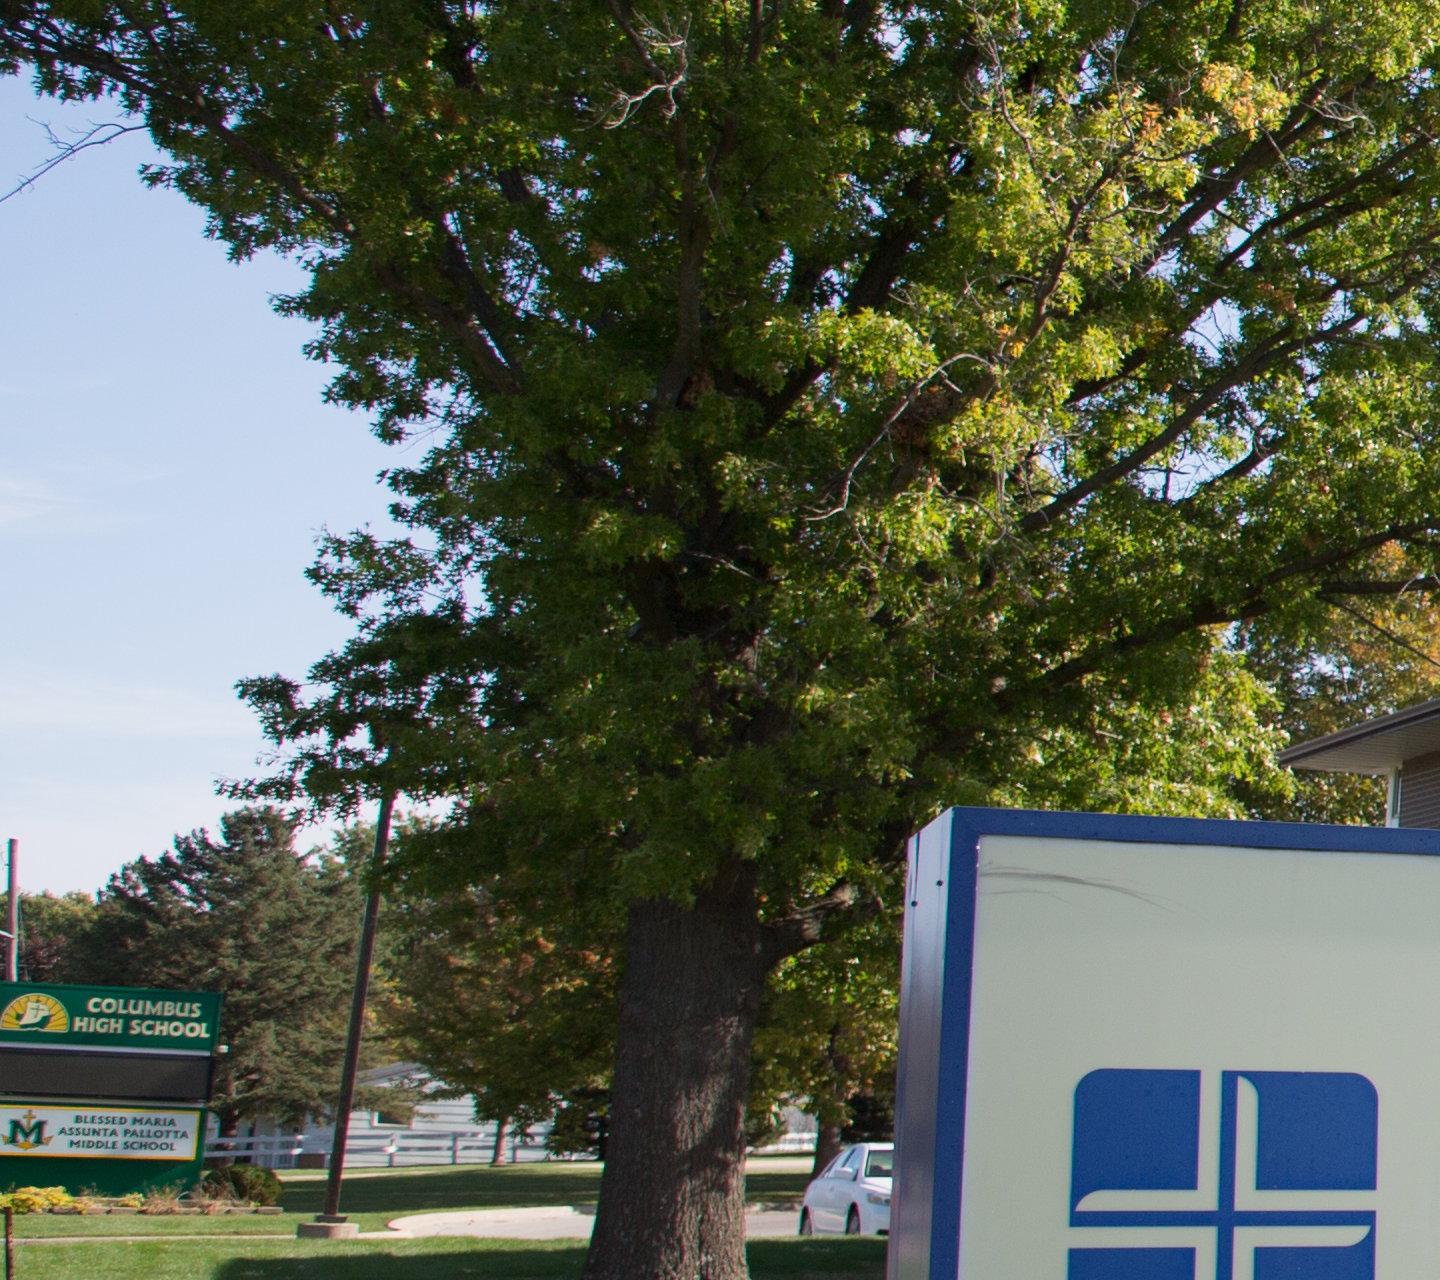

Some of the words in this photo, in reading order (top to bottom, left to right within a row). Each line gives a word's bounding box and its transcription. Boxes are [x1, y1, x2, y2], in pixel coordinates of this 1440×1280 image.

[87, 997, 202, 1018] COLUMBUS
[72, 1016, 124, 1034] HIGH
[129, 1020, 211, 1038] SCHOOL
[73, 1114, 128, 1126] BLESSED
[131, 1116, 177, 1127] MARIA
[58, 1126, 119, 1138] ASSUNTA
[123, 1128, 189, 1140] PALLOTTA
[69, 1139, 119, 1150] MIDDLE
[122, 1140, 176, 1152] SCHOOL
